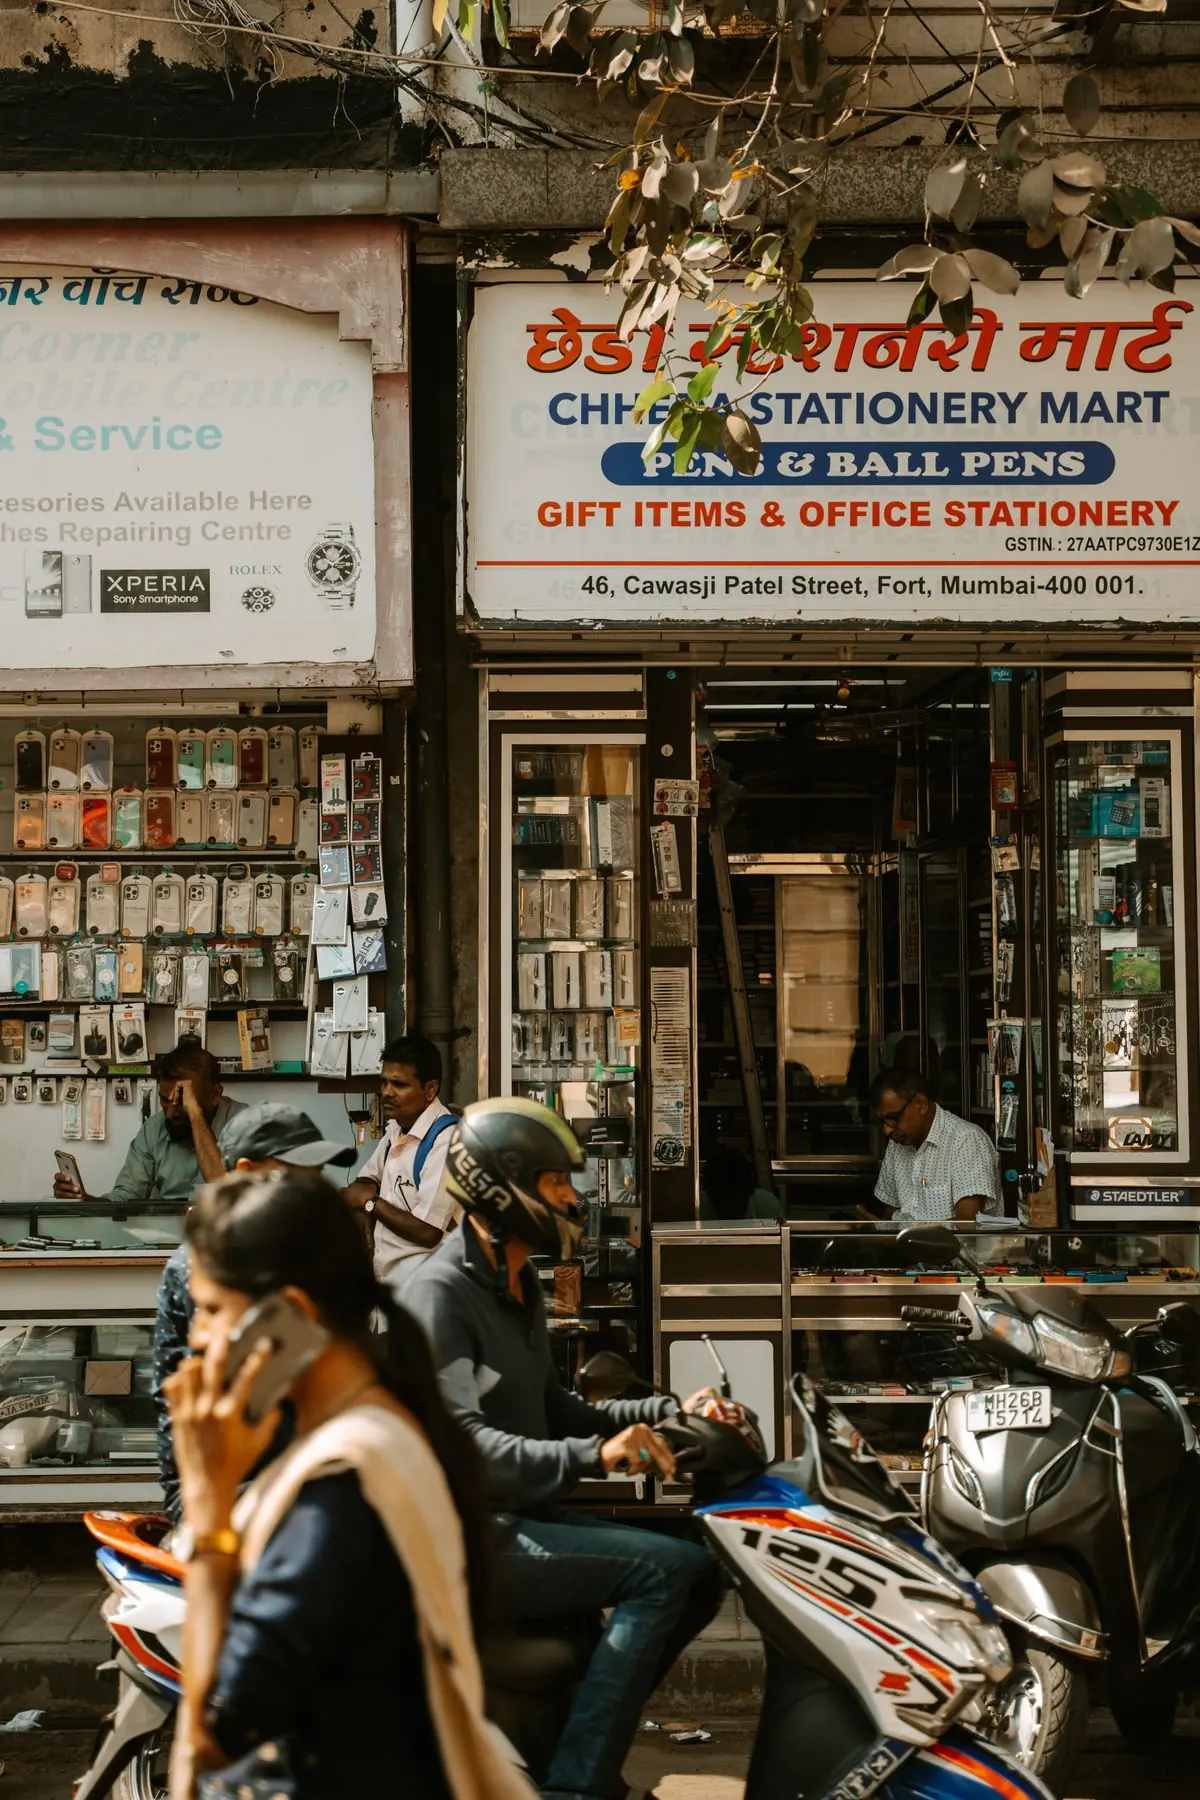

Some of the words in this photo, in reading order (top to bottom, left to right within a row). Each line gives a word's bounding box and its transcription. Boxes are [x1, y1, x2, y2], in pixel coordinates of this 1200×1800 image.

[0, 320, 200, 364] Corner
[1019, 300, 1194, 373] मार्ट
[161, 367, 350, 411] Centre
[548, 392, 736, 426] CHHEA
[750, 391, 1028, 426] STATIONERY
[1041, 390, 1170, 424] MART
[34, 415, 223, 451] Service
[776, 451, 816, 478] &
[826, 451, 949, 478] BALL
[961, 451, 1085, 478] PENS
[0, 493, 105, 513] esories
[114, 491, 242, 512] Available
[249, 490, 312, 511] Here
[537, 501, 621, 527] GIFT
[635, 501, 747, 527] ITEMS
[760, 501, 786, 527] &
[799, 500, 931, 527] OFFICE
[944, 500, 1180, 527] STATIONERY
[59, 521, 191, 546] Repairing
[201, 521, 291, 542] Centre
[1005, 537, 1052, 552] GSTIN
[229, 564, 282, 575] ROLEX
[107, 575, 206, 592] XPERIA
[581, 575, 615, 598] 46,
[623, 575, 716, 599] Cawasji
[725, 575, 783, 595] Patel
[791, 575, 869, 598] Street,
[877, 575, 932, 598] Fort,
[941, 575, 1087, 595] Mumbai-400
[1095, 575, 1144, 595] 001.
[113, 593, 138, 606] Sony
[138, 593, 199, 606] Smartphone
[984, 1391, 1042, 1410] MH26B
[740, 1526, 888, 1610] 125
